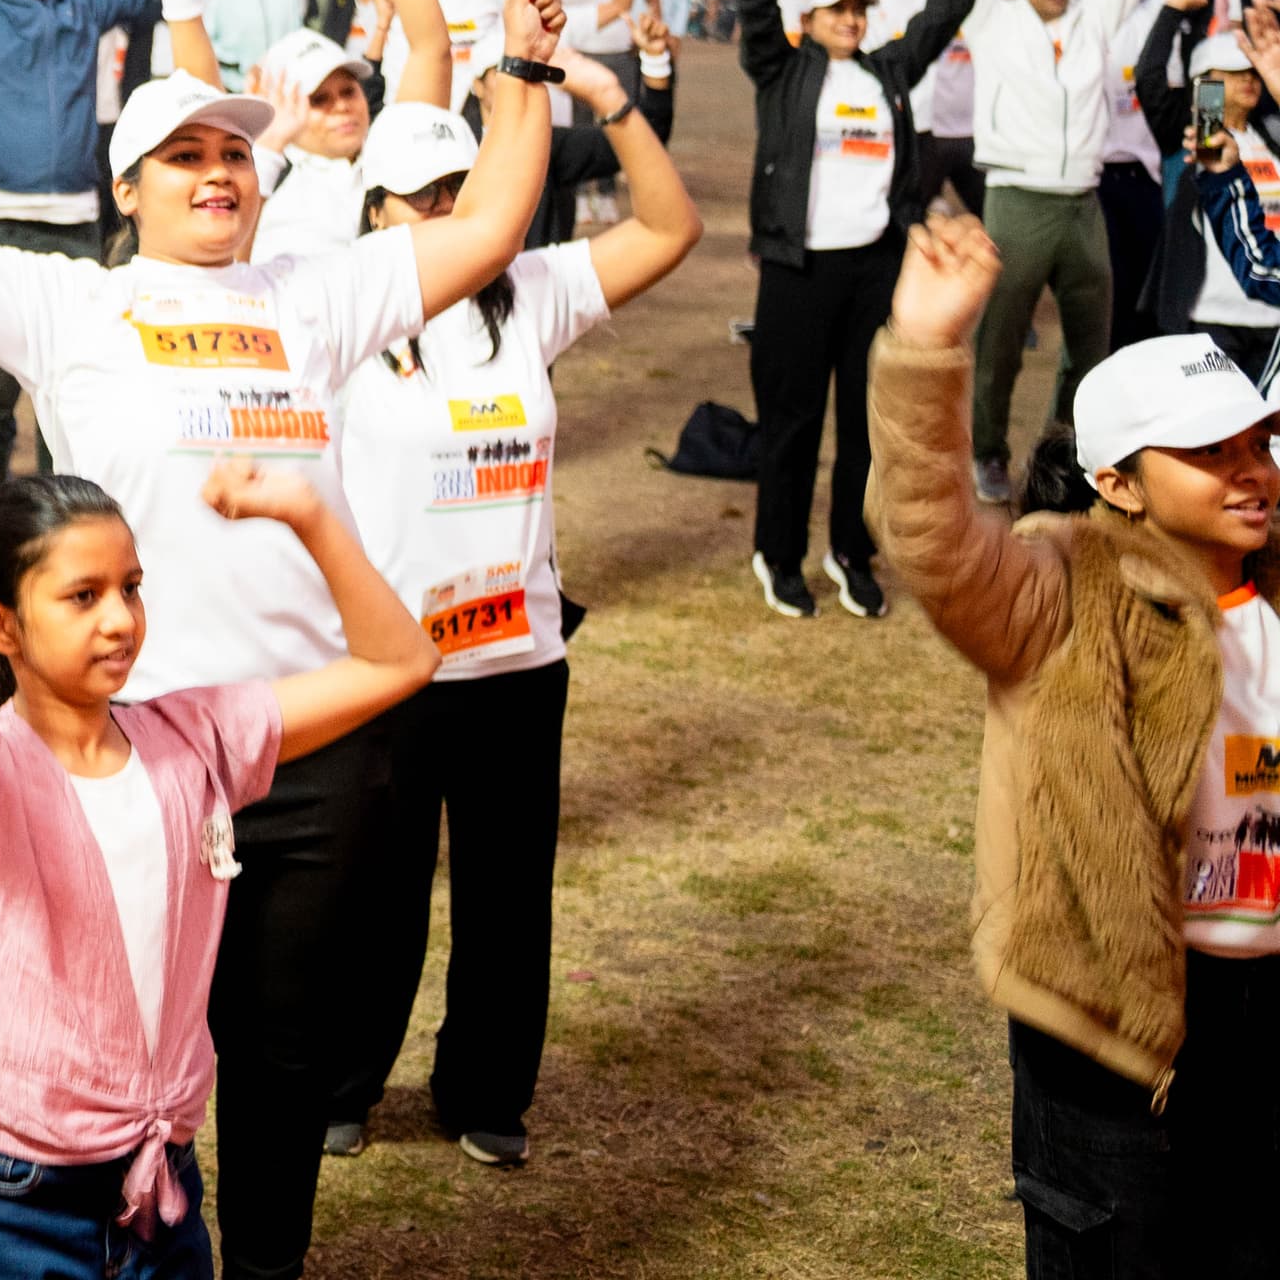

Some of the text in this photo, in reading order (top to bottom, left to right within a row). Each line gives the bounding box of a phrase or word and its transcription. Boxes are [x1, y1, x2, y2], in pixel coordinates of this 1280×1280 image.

[155, 330, 273, 355] 51735
[229, 407, 330, 442] INDORE
[430, 598, 512, 643] 51731
